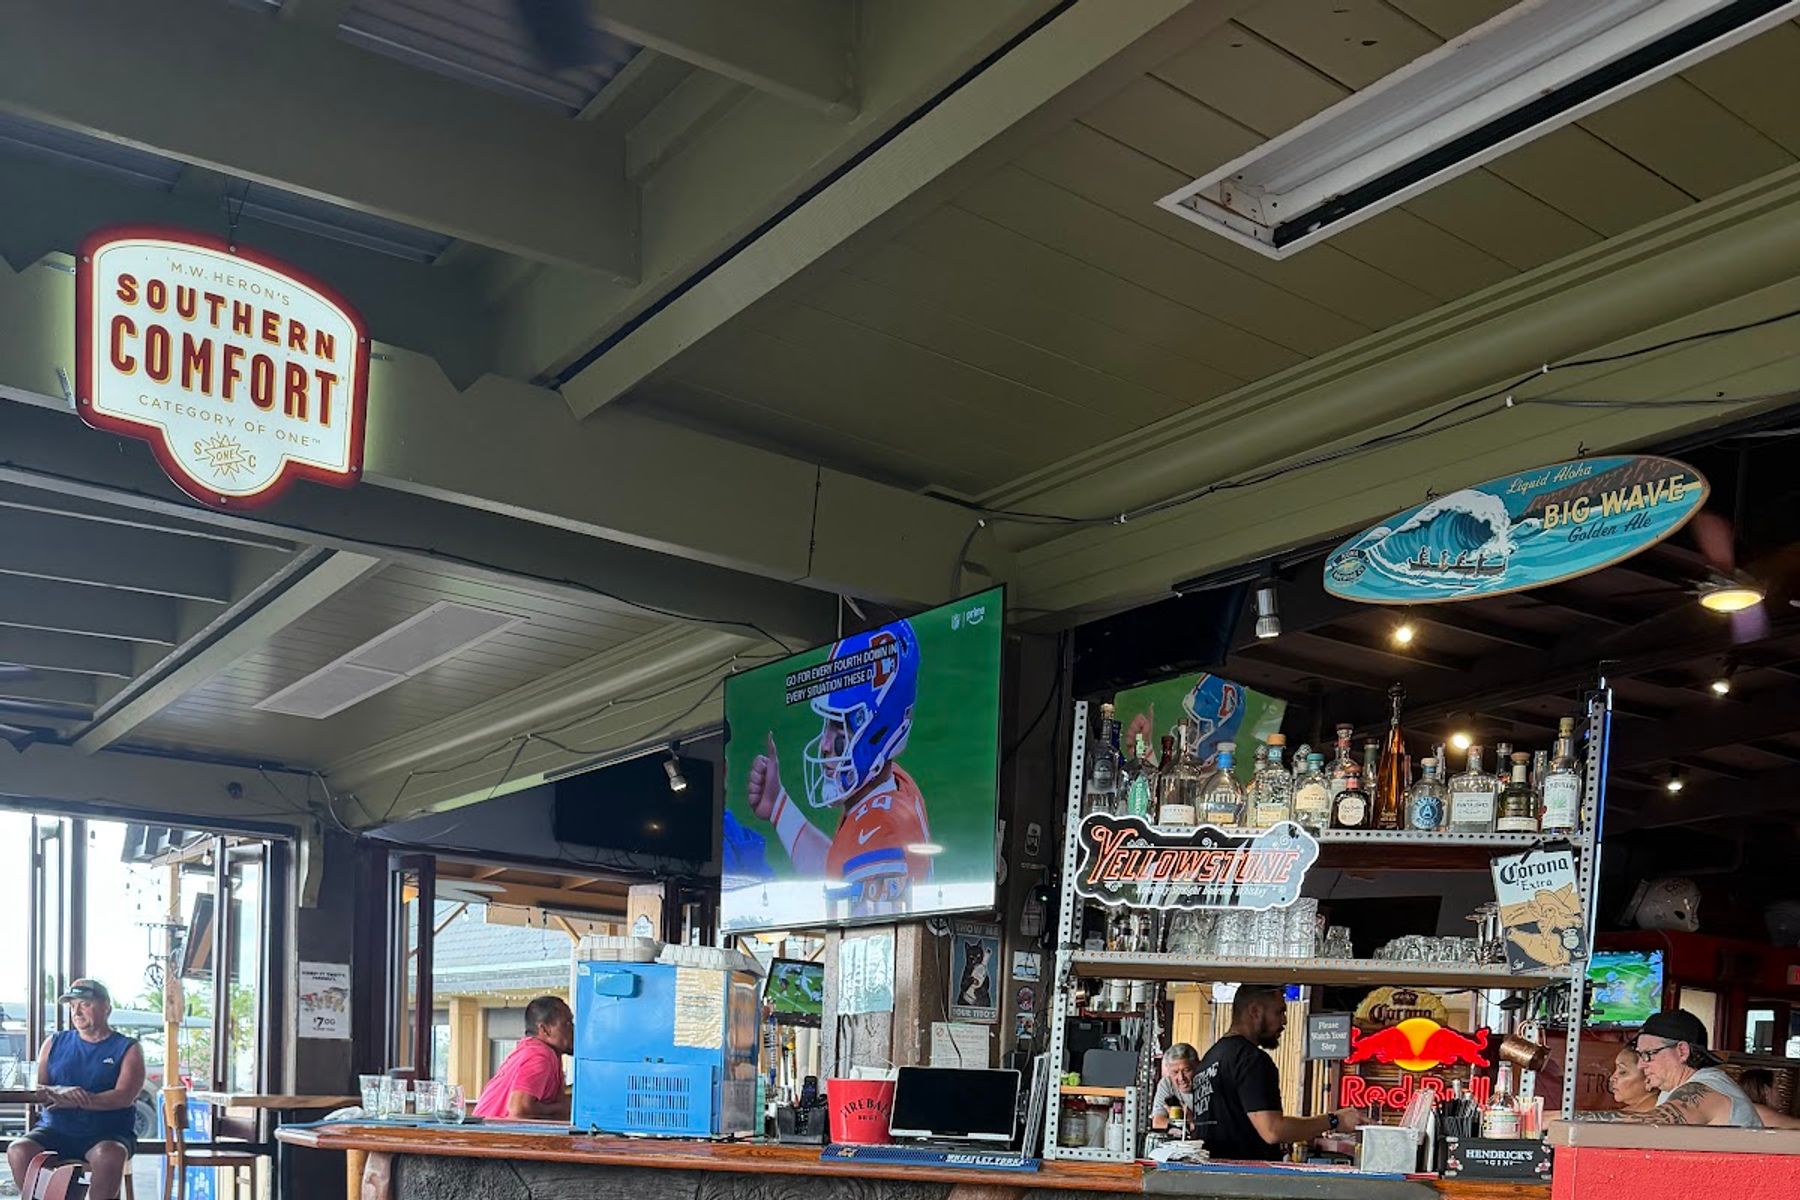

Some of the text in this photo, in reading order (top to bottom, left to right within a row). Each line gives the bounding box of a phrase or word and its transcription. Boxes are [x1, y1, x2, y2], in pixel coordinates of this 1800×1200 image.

[170, 261, 290, 306] M.W. HERON'S
[116, 272, 336, 361] SOUTHERN
[110, 314, 338, 428] COMFORT
[139, 394, 235, 426] CATEGORY
[244, 421, 267, 434] OF
[194, 441, 256, 467] S ONE C
[1506, 463, 1592, 495] Liquid Aloha
[1544, 474, 1684, 529] BIG WAVE
[1568, 511, 1652, 543] Golden Ale
[786, 675, 796, 687] GO
[798, 670, 811, 682] FOR
[812, 664, 833, 679] EVERY
[834, 653, 863, 672] FOURTH
[863, 645, 888, 662] DOWN
[786, 689, 806, 704] EVERY
[807, 679, 843, 698] SITUATION
[844, 670, 865, 687] THESE
[1500, 858, 1569, 884] Corona
[1522, 879, 1553, 891] Extra
[1318, 1021, 1339, 1030] Please
[1369, 1003, 1432, 1024] Corona
[1311, 1032, 1348, 1040] Watch Your
[1321, 1042, 1337, 1052] Step
[1341, 1075, 1414, 1109] Red
[1466, 1149, 1534, 1160] HENDRICK'S
